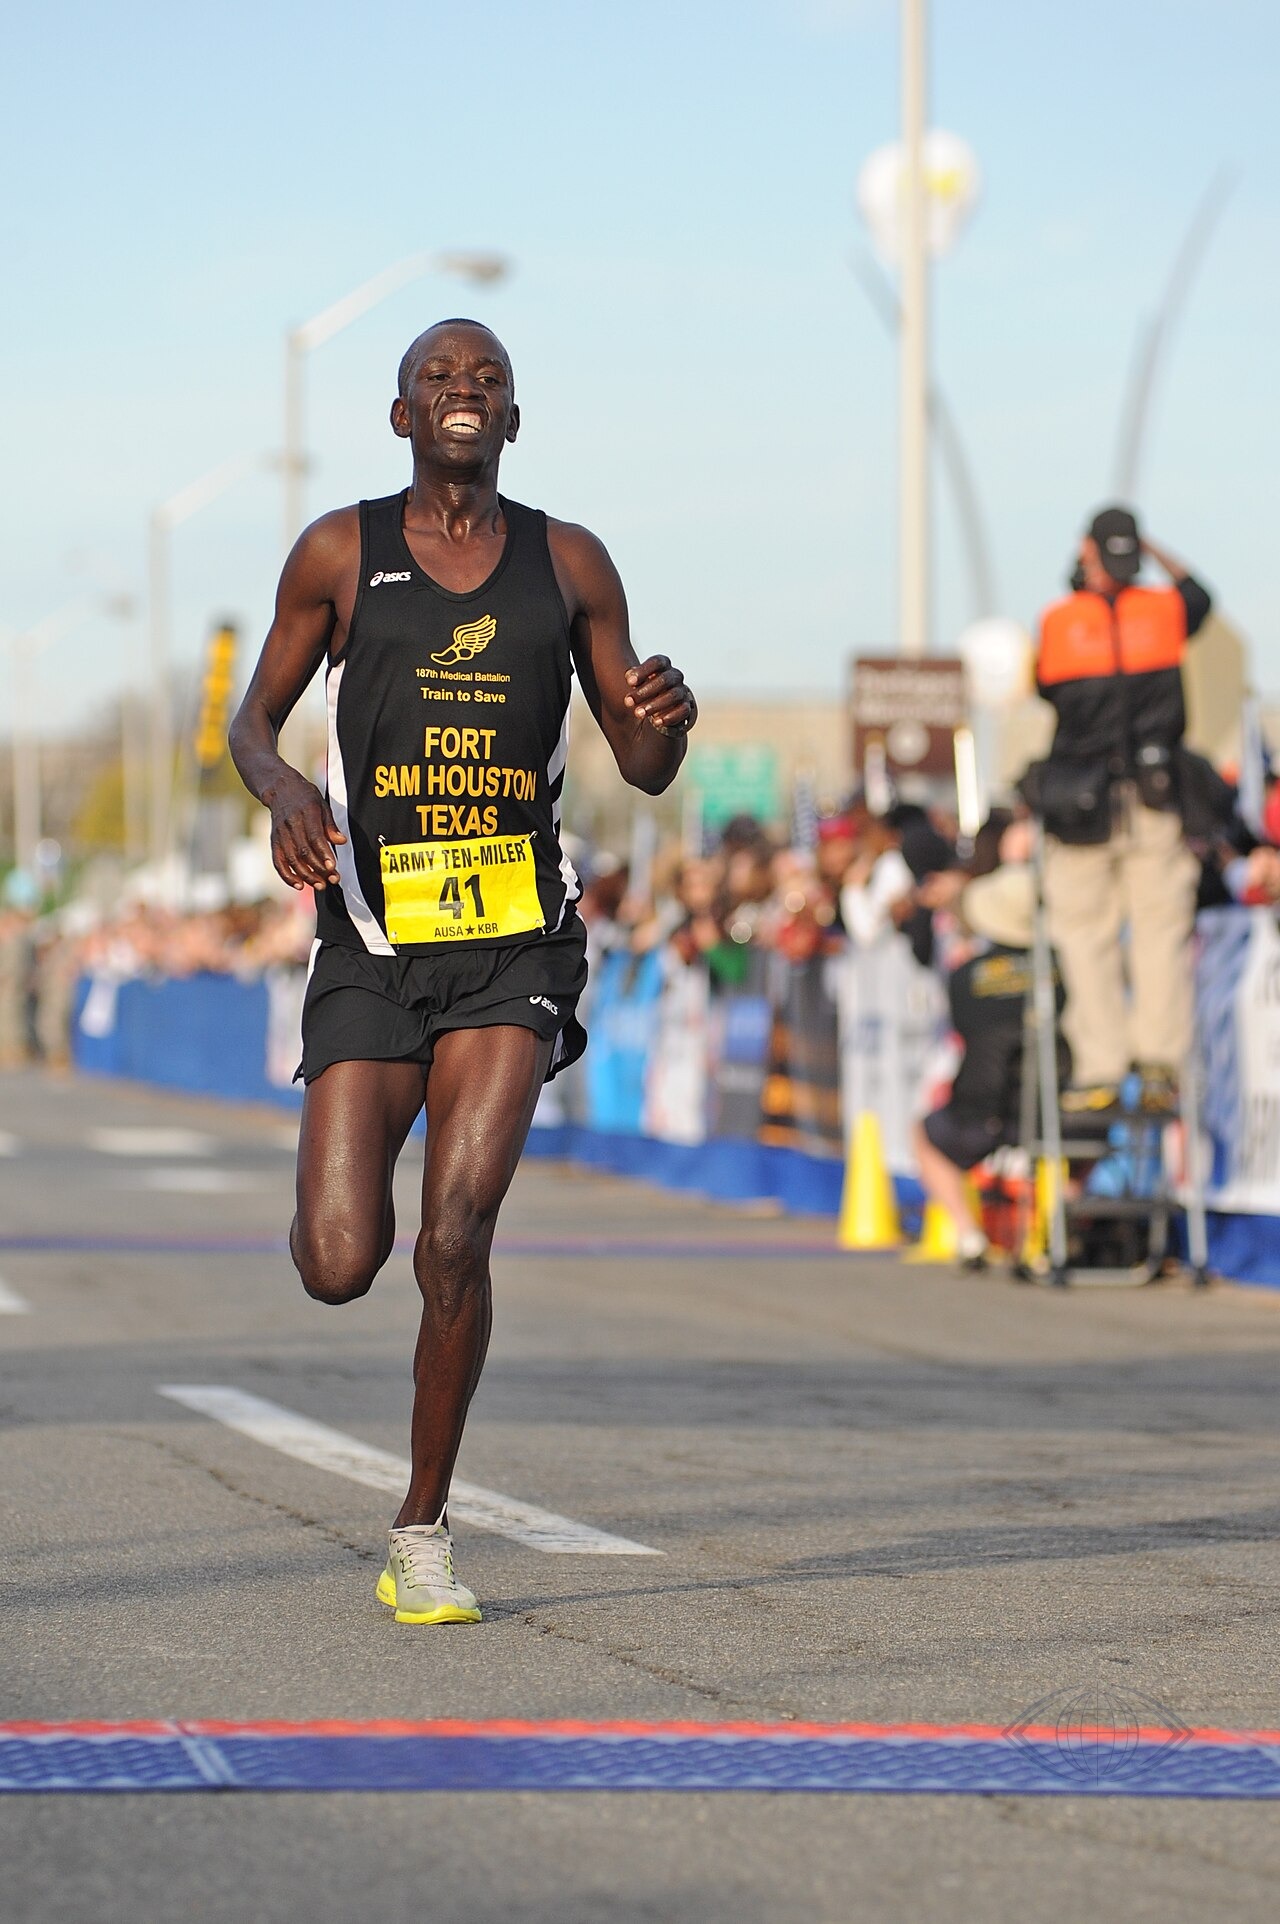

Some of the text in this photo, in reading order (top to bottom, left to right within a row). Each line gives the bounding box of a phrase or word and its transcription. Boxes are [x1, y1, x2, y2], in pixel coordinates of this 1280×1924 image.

[383, 571, 411, 583] asics
[415, 668, 511, 683] 187th Medical Battalion
[421, 687, 506, 703] Train to Save
[424, 727, 497, 760] FORT
[374, 765, 537, 801] SAM HOUSTON
[416, 805, 498, 836] TEXAS
[389, 842, 526, 874] ARMY TEN-MILER
[438, 874, 485, 920] 41
[434, 923, 499, 938] AUSA KBR
